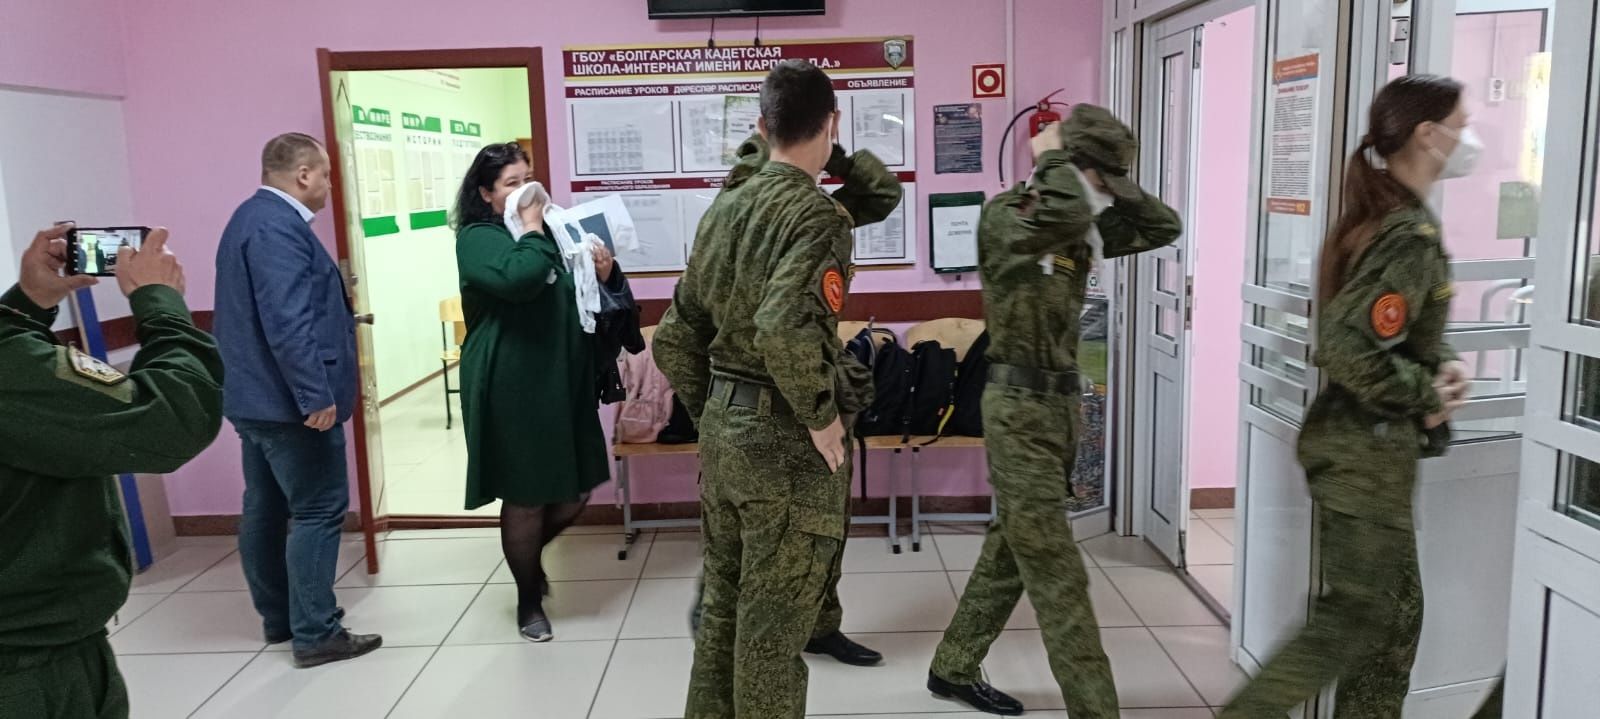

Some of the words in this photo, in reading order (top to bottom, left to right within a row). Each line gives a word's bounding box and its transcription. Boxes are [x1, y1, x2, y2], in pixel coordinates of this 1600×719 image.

[572, 51, 606, 63] ГБОУ
[609, 48, 701, 62] «БОЛГАРСКАЯ
[704, 46, 782, 60] КАДЕТСКАЯ
[572, 61, 691, 75] ШКОЛА-ИНТЕРНАТ
[695, 60, 742, 72] ИМЕНИ
[744, 58, 797, 71] КАРП
[718, 82, 762, 93] РАСПИСАН
[847, 78, 908, 88] ОБЪЯВЛЕНИЕ
[574, 86, 633, 97] РАСПИСАНИЕ
[634, 86, 669, 96] УРОКОВ
